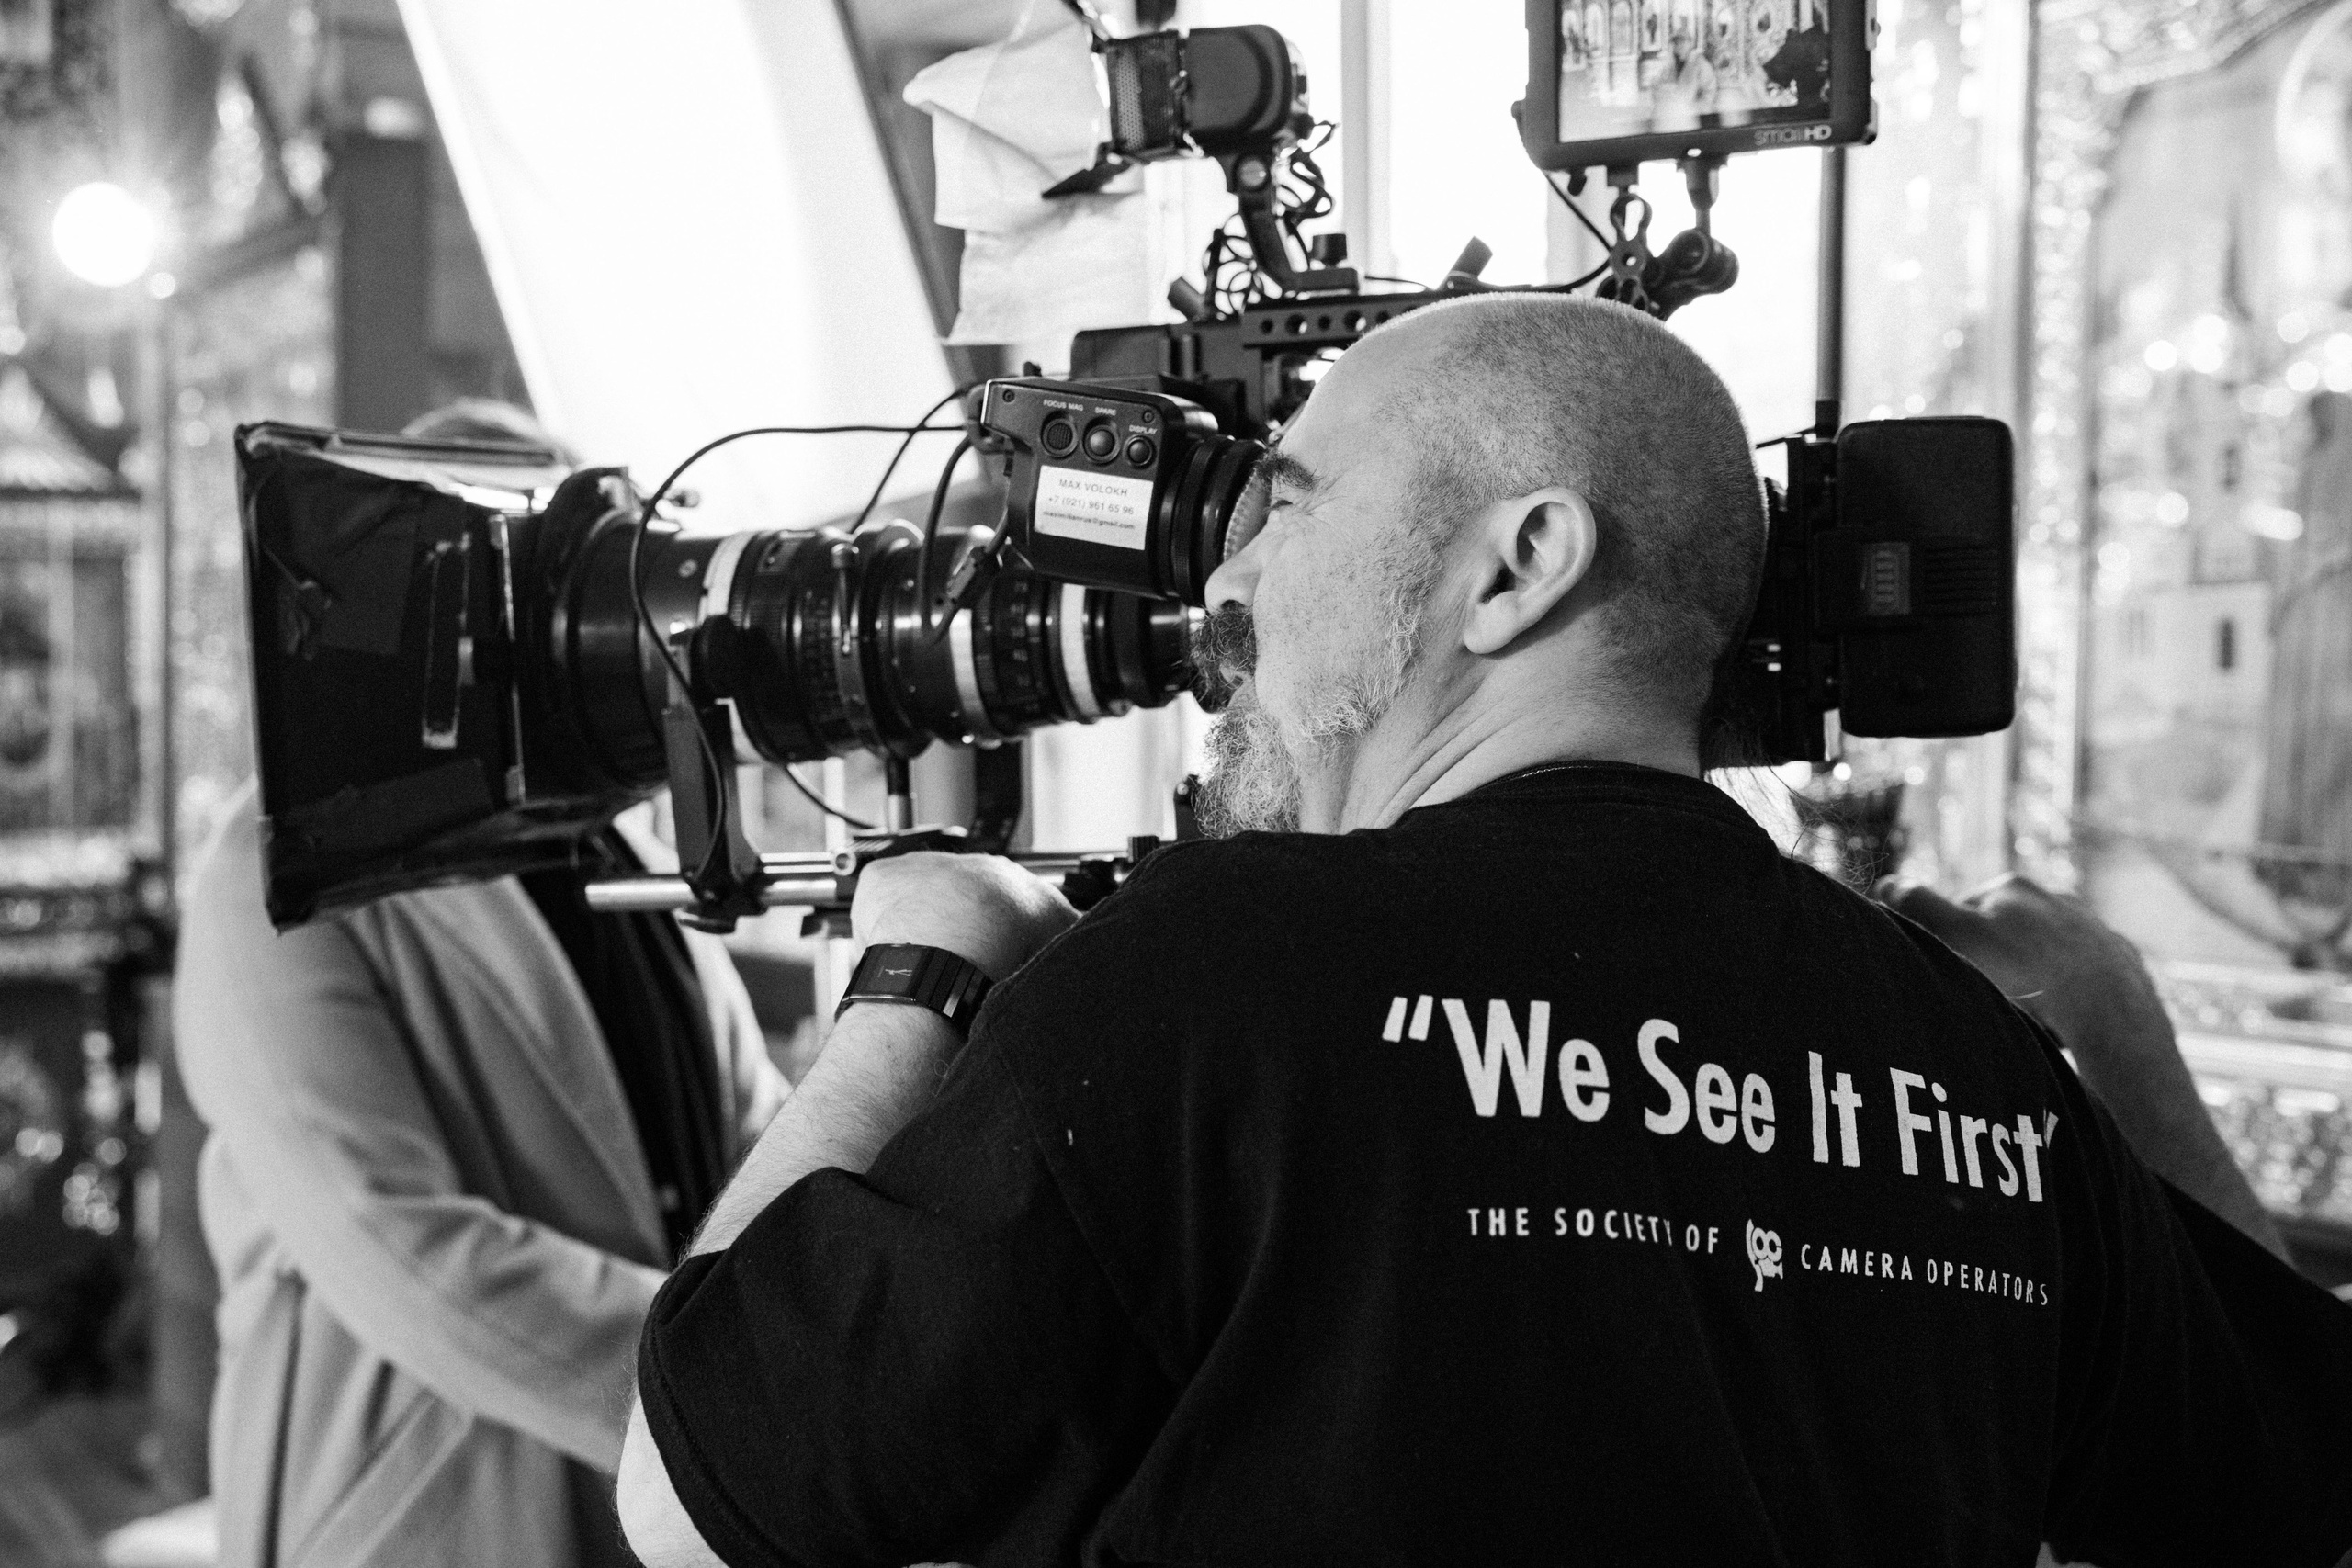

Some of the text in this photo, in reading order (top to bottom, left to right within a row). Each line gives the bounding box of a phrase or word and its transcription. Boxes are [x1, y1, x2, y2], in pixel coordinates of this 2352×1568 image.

[1043, 399, 1084, 412] FOCUS MAG
[1094, 406, 1117, 416] SPARE
[1128, 424, 1158, 435] DISPLAY
[1058, 479, 1128, 497] MAX VOLOKH
[1089, 501, 1105, 511] 961
[1122, 505, 1134, 515] 96
[1636, 1018, 1777, 1154] See
[1807, 1050, 1863, 1168] It
[1467, 1207, 2049, 1306] THE SOCIETY OF CAMERA OPERATORS
